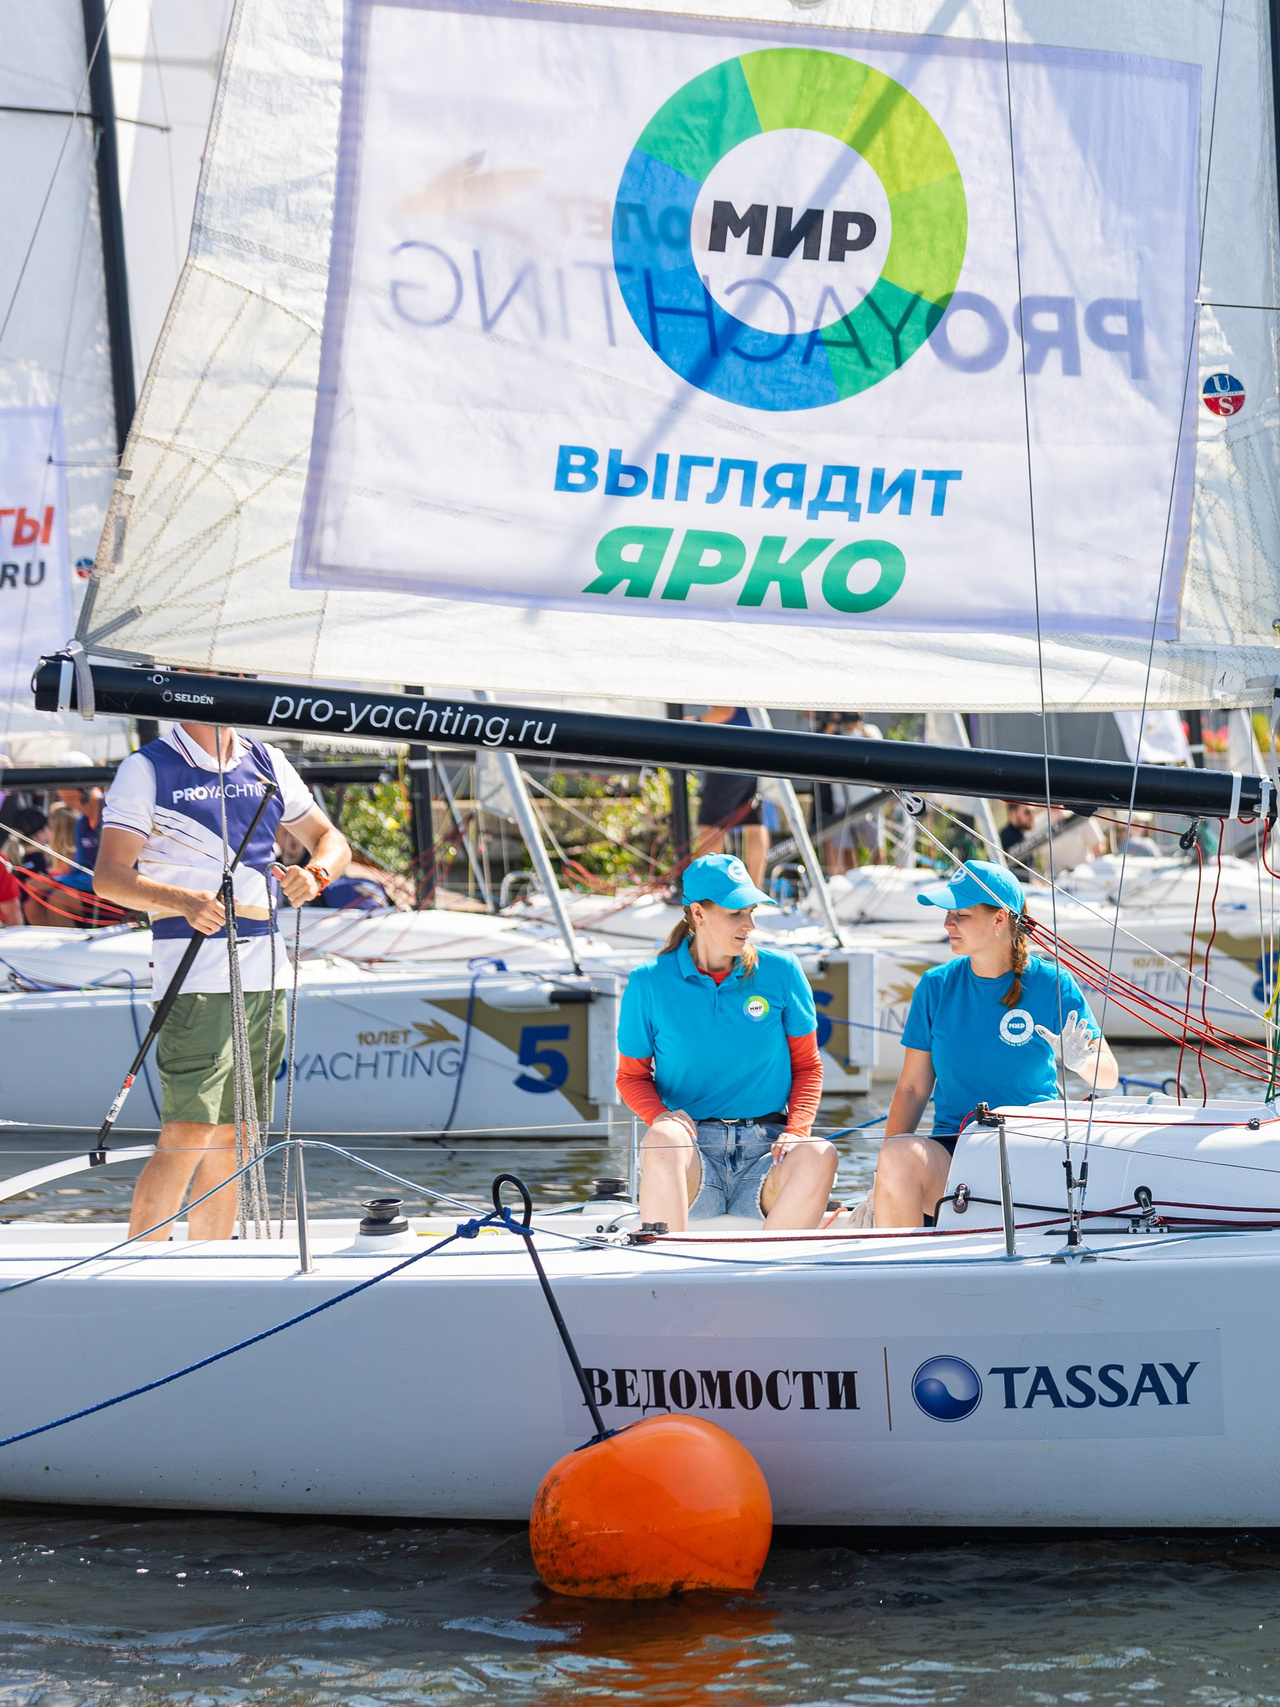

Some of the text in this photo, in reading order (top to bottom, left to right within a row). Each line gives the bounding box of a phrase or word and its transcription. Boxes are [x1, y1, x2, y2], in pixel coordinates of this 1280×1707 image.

[708, 199, 877, 263] МИР
[553, 444, 963, 522] ВЫГЛЯДИТ
[581, 525, 907, 614] ЯРКО
[267, 693, 558, 746] pro-yachting.ru
[171, 783, 269, 804] PROYACHTIN
[356, 1029, 411, 1046] 10ЛЕТ
[513, 1024, 571, 1094] 5
[582, 1367, 861, 1416] ВЕДОМОСТИ
[988, 1361, 1202, 1409] TASSAY
